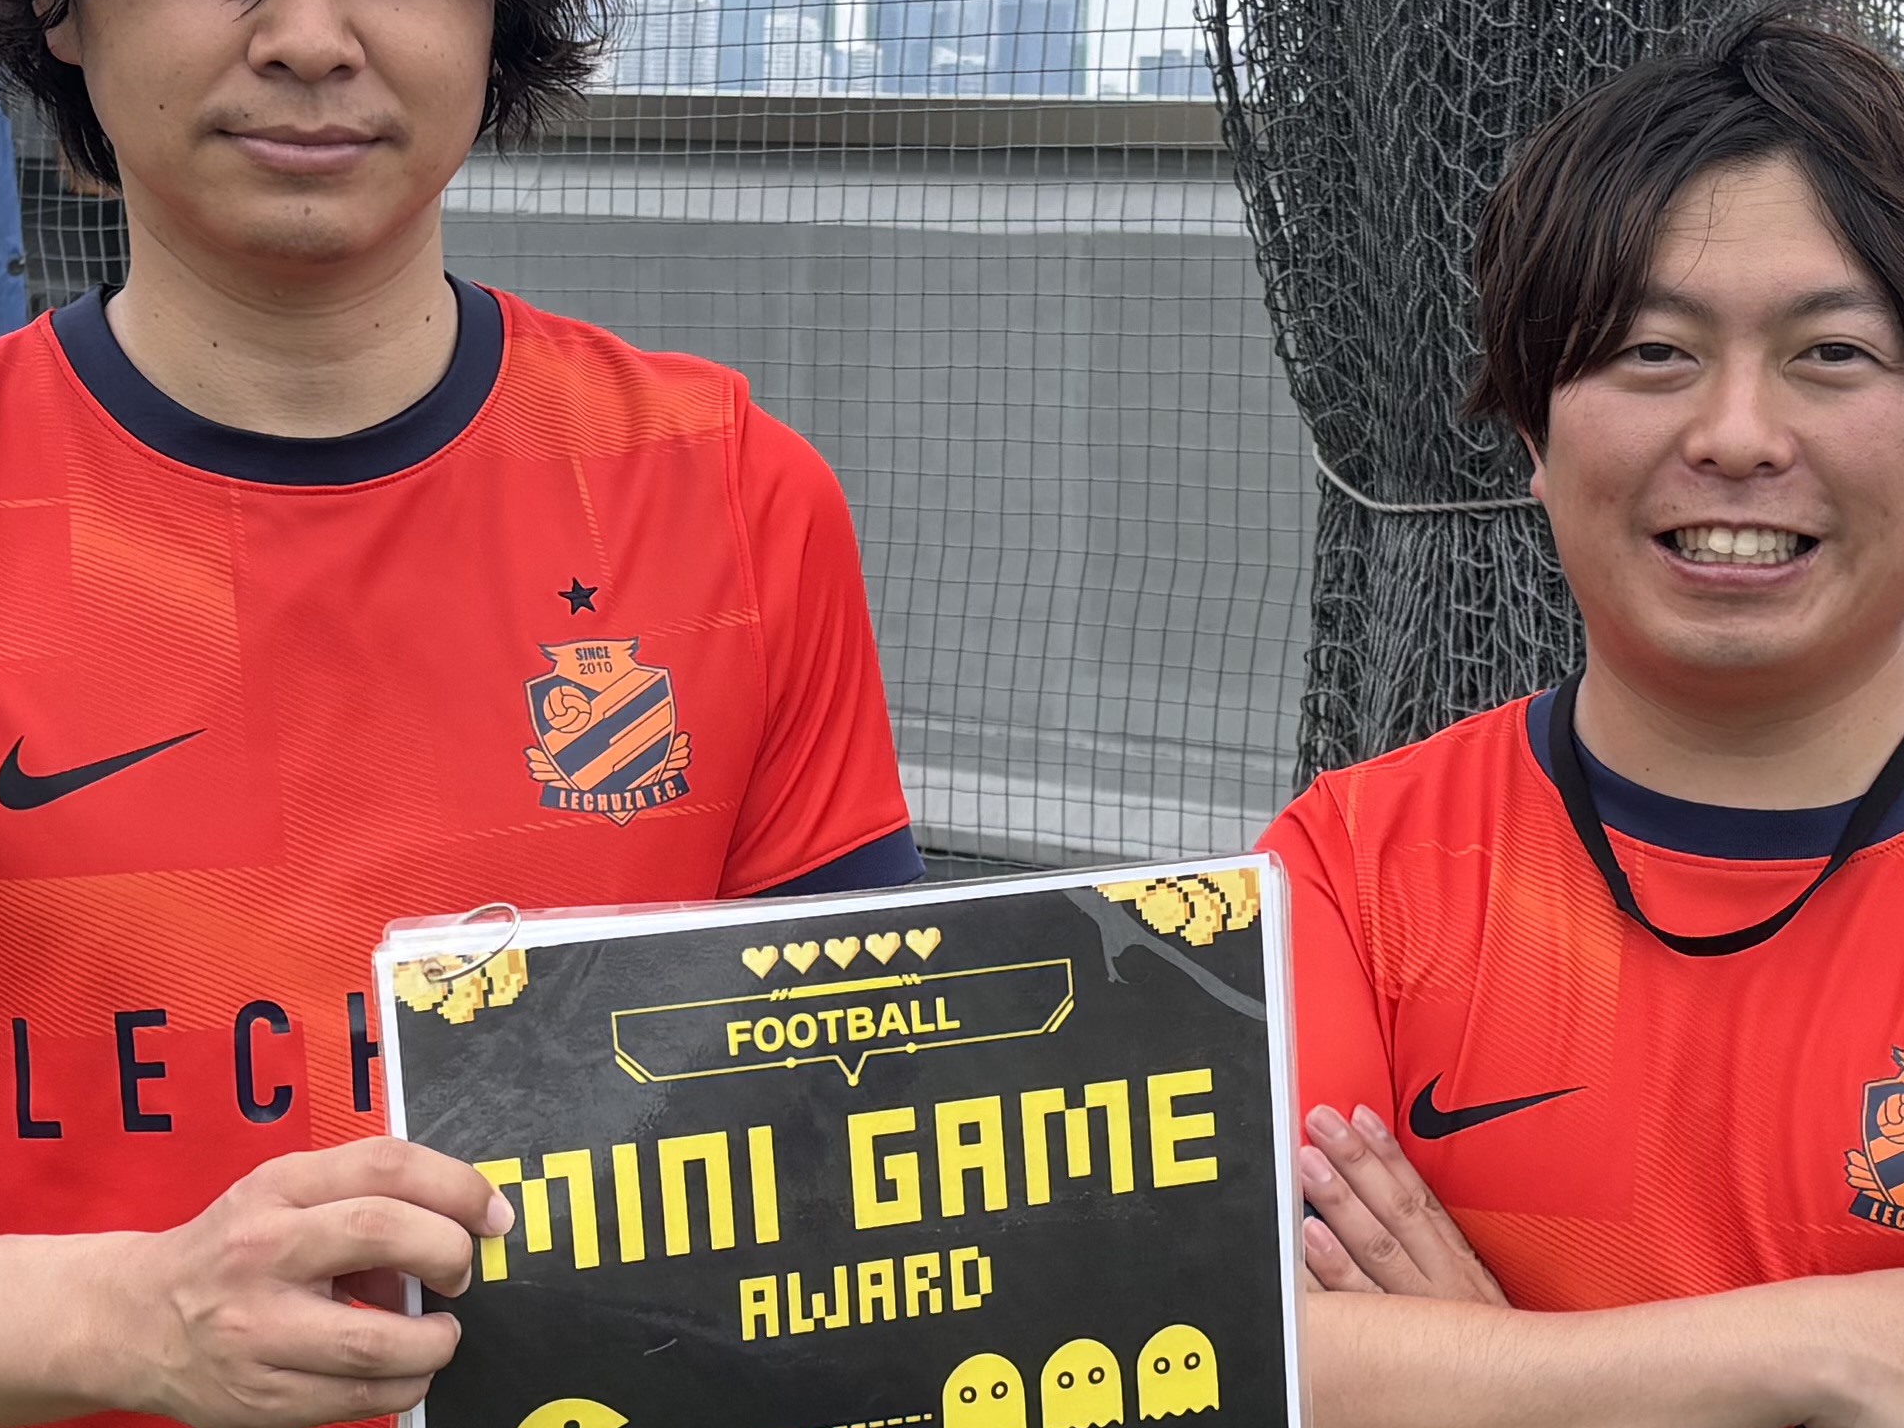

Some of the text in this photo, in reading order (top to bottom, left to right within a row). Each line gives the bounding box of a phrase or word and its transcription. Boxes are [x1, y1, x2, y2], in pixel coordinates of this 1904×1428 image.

[575, 646, 611, 661] SINCE
[578, 661, 613, 676] 2010
[559, 780, 683, 812] LECHUZA F.C.
[726, 996, 961, 1056] FOOTBALL
[472, 1068, 1219, 1282] MINI GAME
[739, 1246, 994, 1341] AWARD
